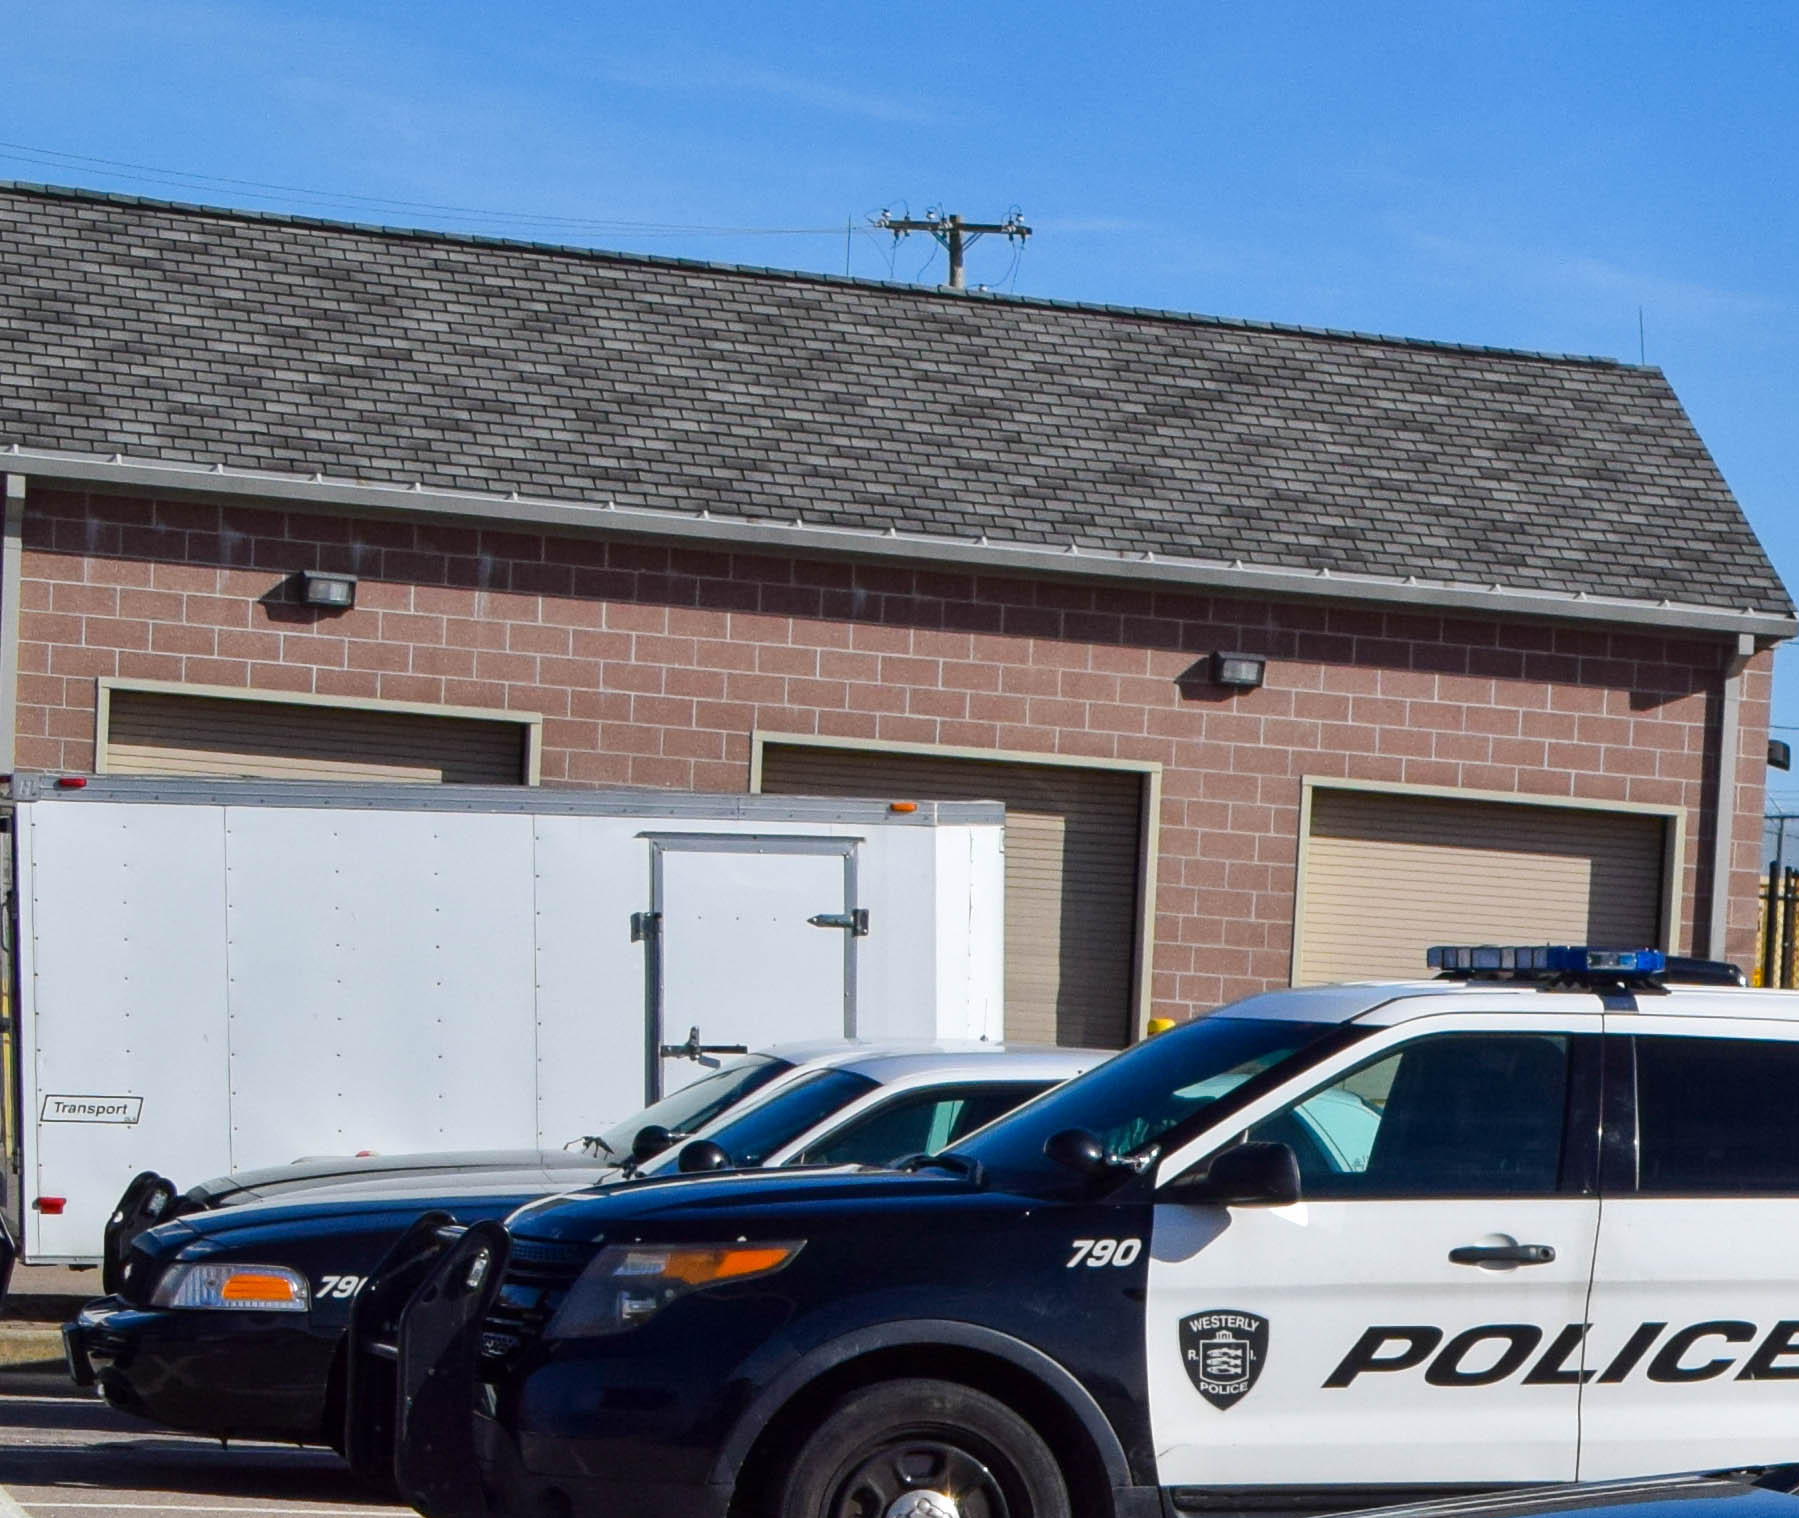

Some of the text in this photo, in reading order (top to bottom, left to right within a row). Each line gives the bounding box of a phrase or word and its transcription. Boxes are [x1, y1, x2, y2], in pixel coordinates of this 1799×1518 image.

[54, 1101, 128, 1116] Transport
[1066, 1238, 1142, 1267] 790
[1189, 1315, 1261, 1332] WESTERLY
[1200, 1381, 1249, 1394] POLICE
